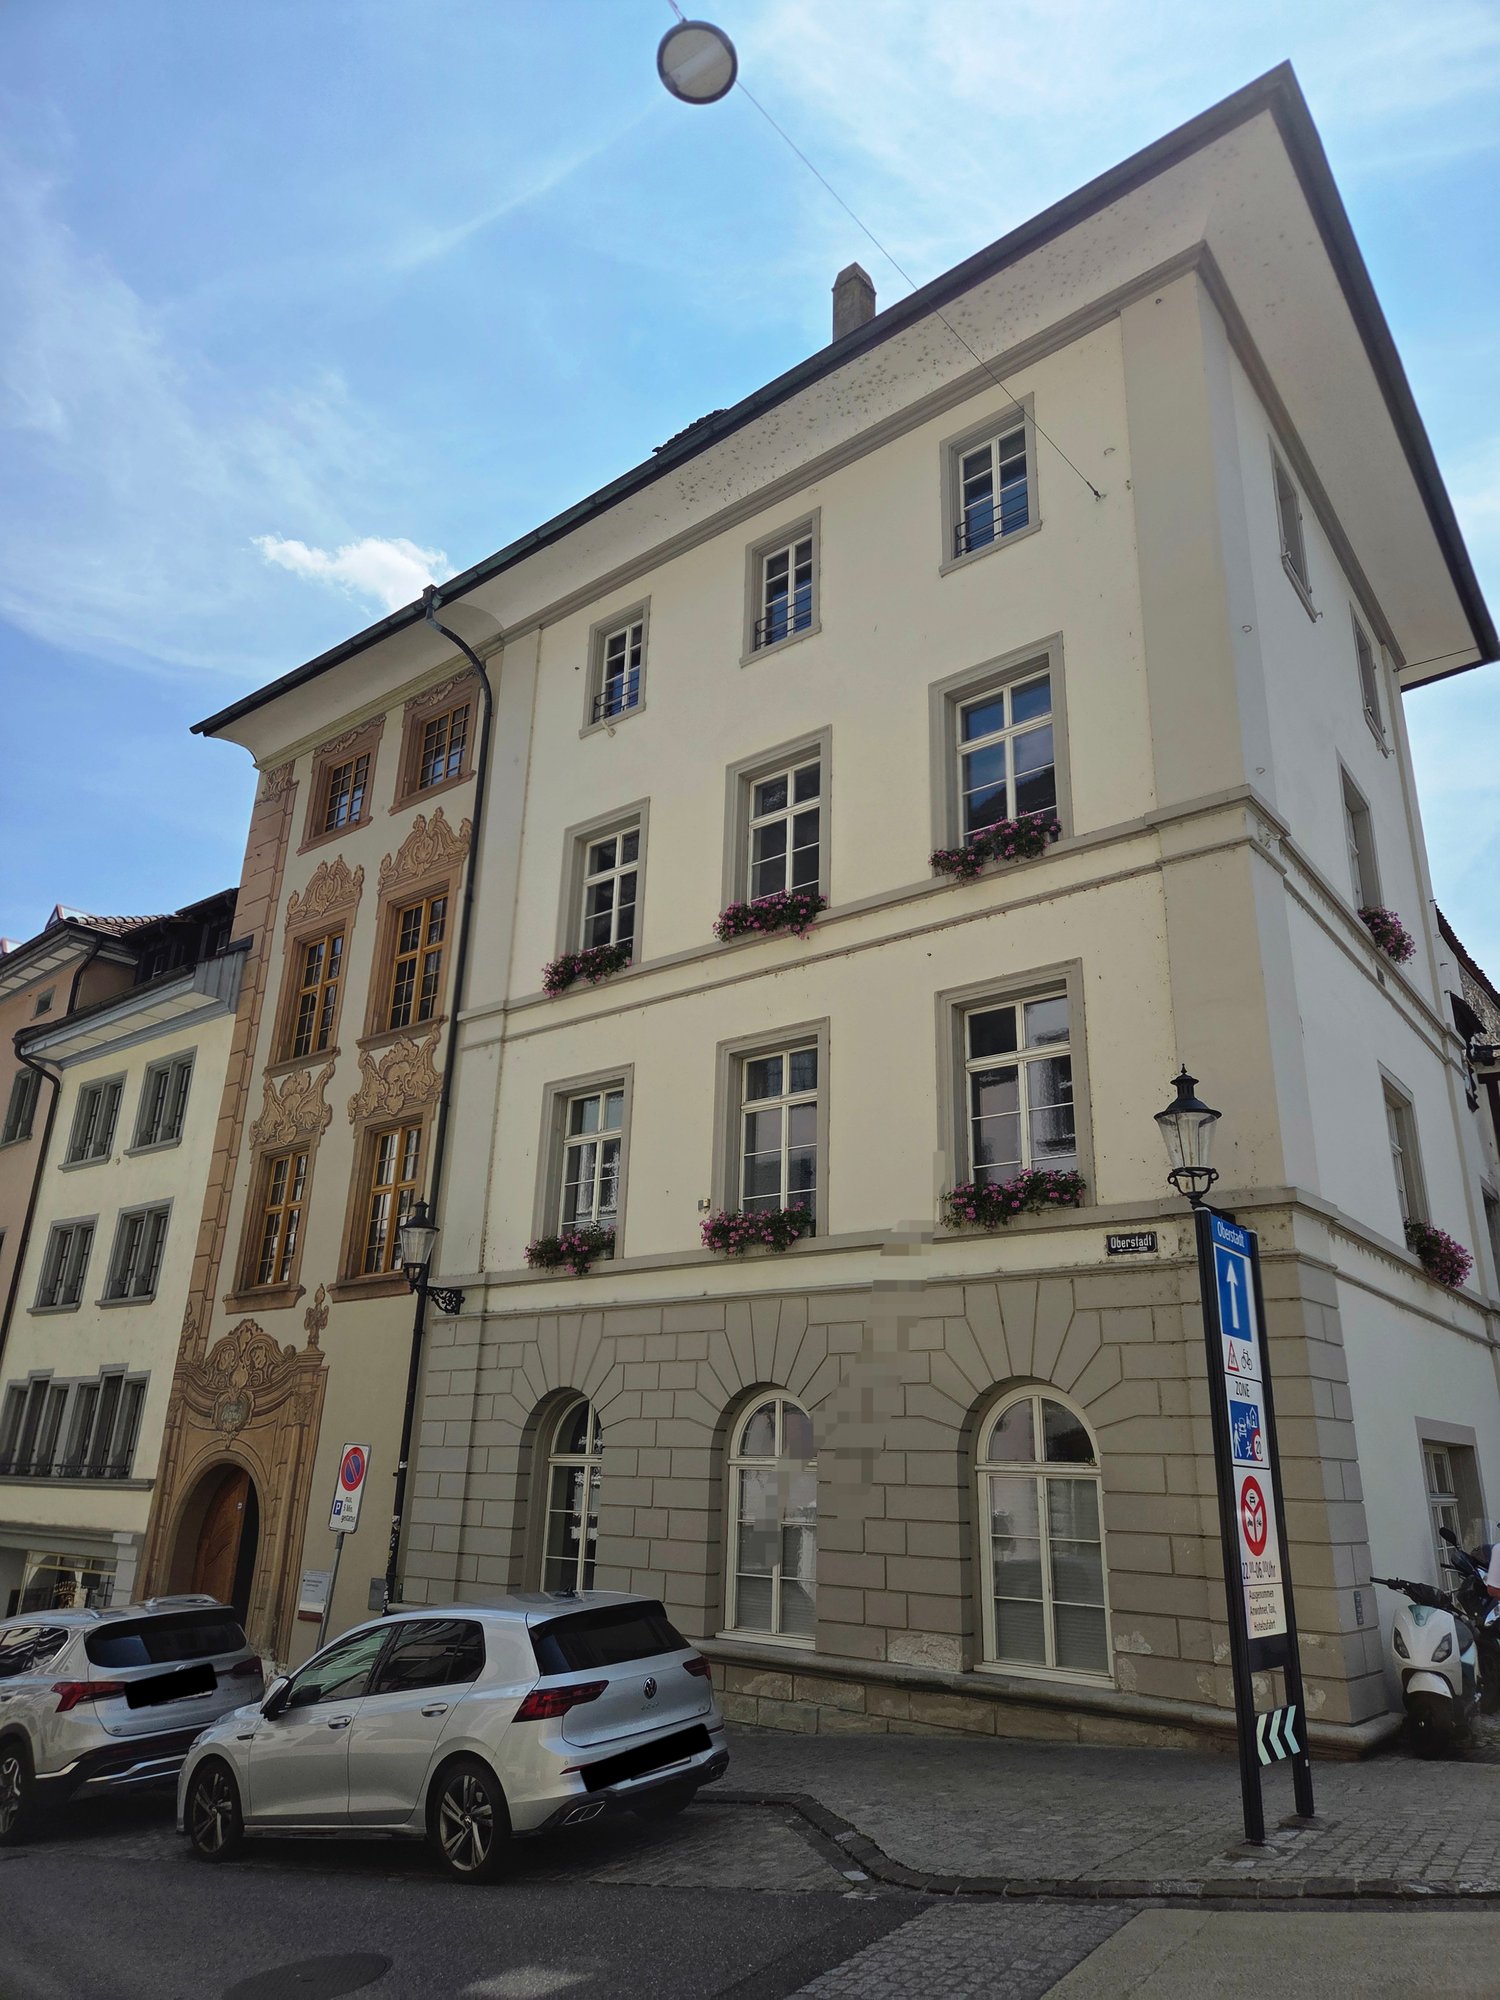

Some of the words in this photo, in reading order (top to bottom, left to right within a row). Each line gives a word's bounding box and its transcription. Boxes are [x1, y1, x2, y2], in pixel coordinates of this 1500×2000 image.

[1110, 1234, 1152, 1248] Oberstadt
[1217, 1221, 1245, 1248] Oberstadt
[1235, 1381, 1250, 1398] ZONE
